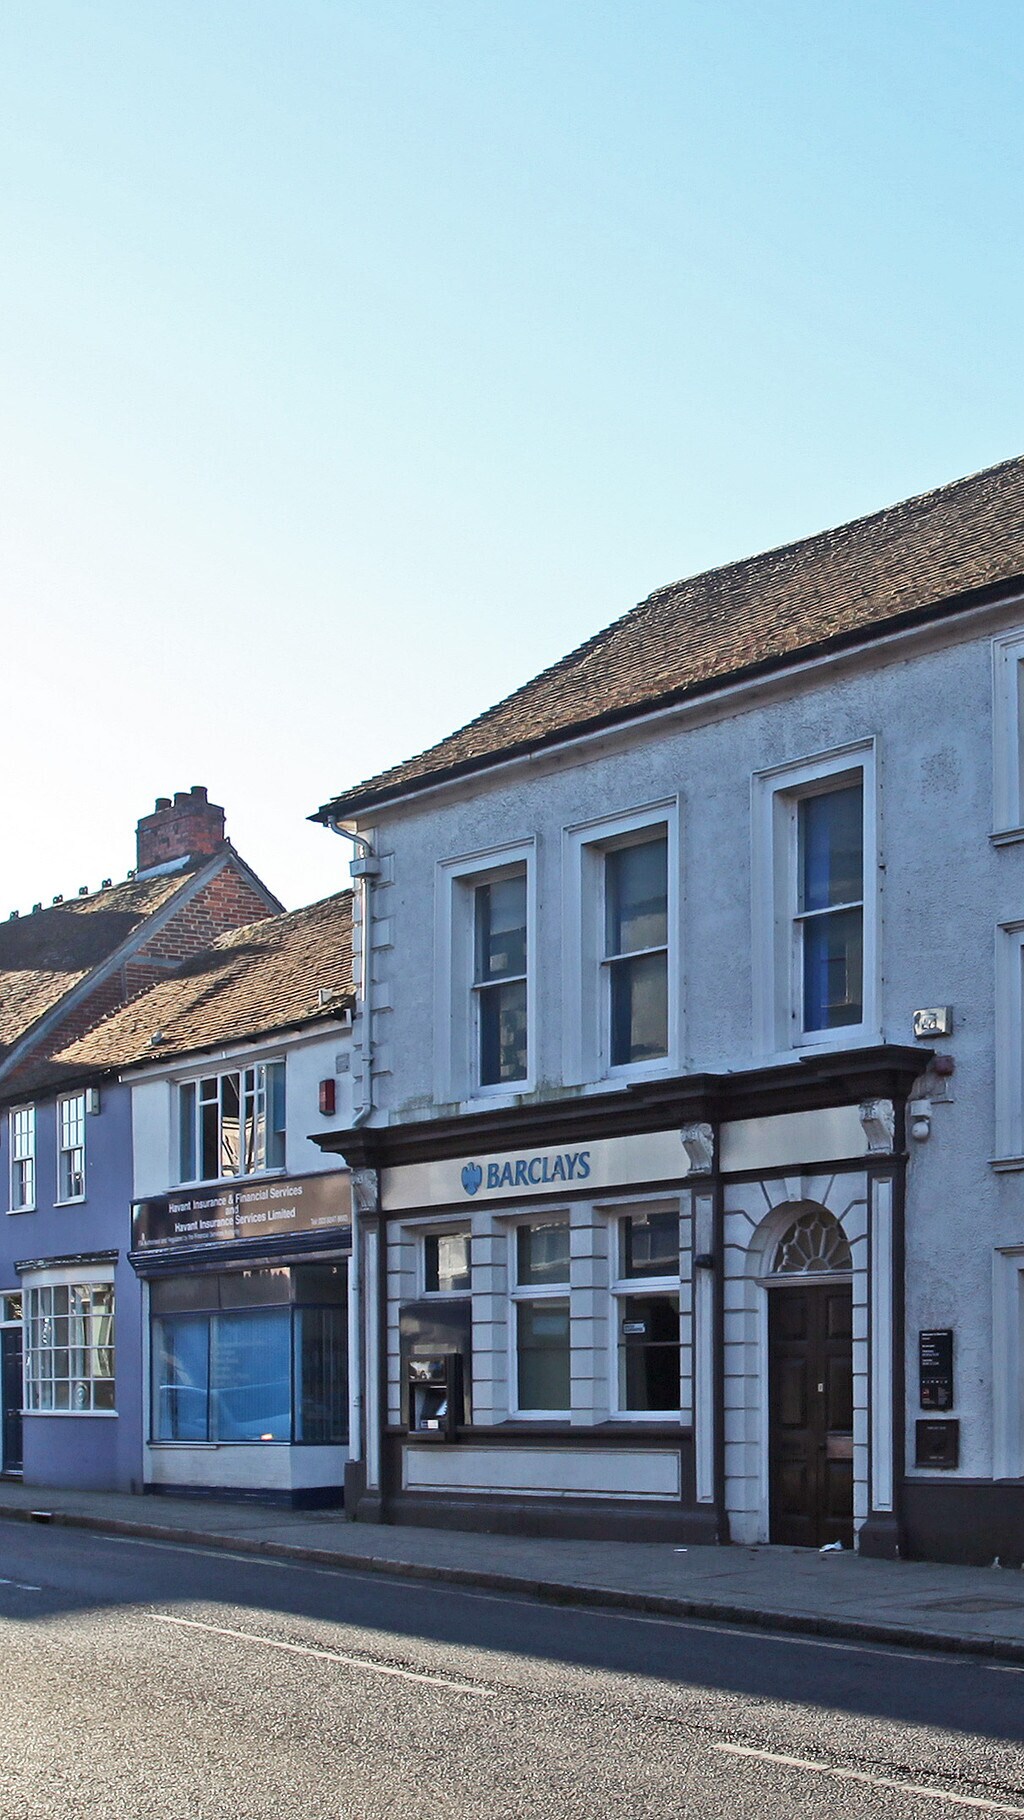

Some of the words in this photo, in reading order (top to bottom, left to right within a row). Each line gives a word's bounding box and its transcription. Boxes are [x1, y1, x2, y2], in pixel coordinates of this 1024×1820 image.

[486, 1151, 591, 1188] BARCLAYS
[168, 1200, 192, 1213] Havant
[193, 1196, 226, 1210] Insurance
[228, 1194, 234, 1204] &
[235, 1189, 269, 1203] Financial
[269, 1185, 303, 1199] Services
[225, 1204, 239, 1216] and
[174, 1220, 199, 1233] Havant
[199, 1216, 234, 1230] Insurance
[235, 1211, 267, 1225] Services
[267, 1206, 296, 1221] Limited
